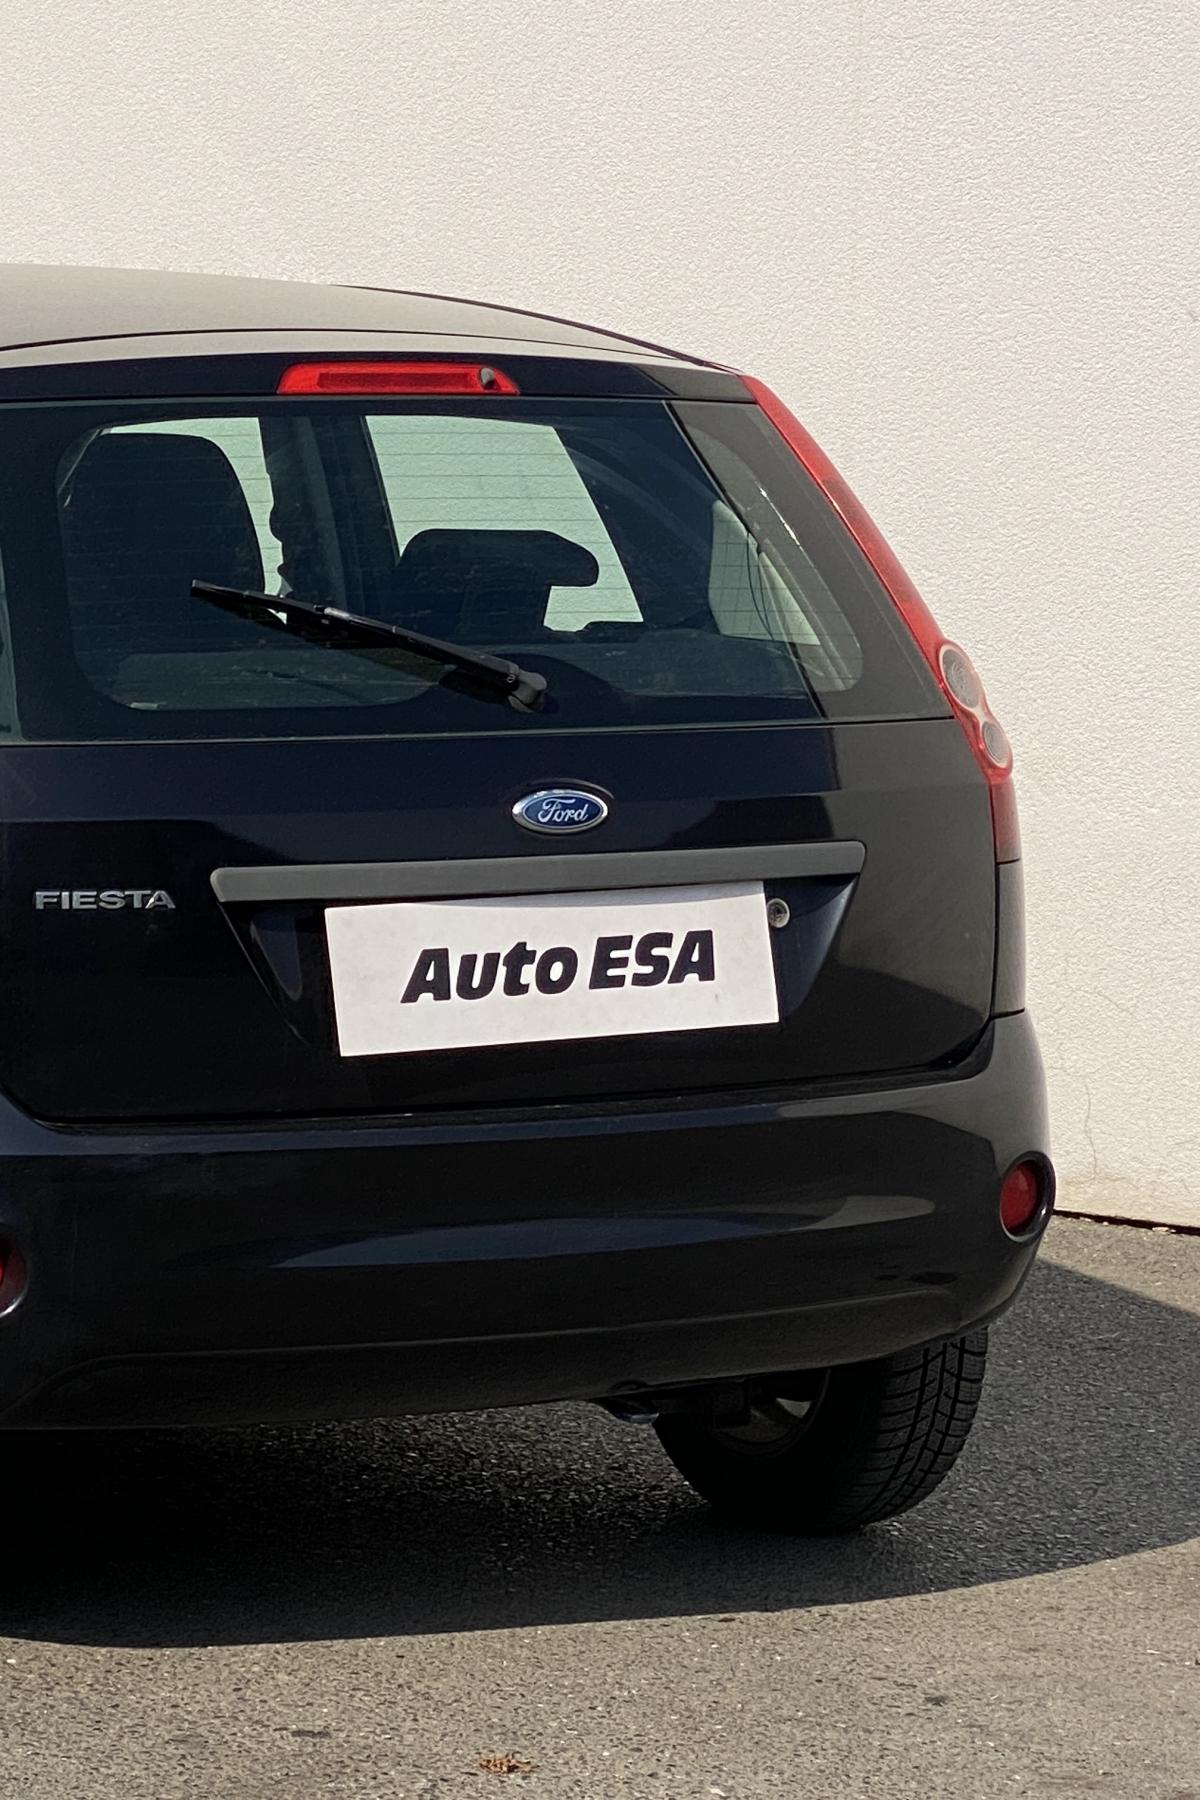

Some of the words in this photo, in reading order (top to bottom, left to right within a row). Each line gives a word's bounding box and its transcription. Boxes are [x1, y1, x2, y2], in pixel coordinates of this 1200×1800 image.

[538, 798, 589, 822] Ford
[35, 890, 176, 910] FIESTA
[400, 941, 579, 1003] Auto
[588, 930, 716, 990] ESA
